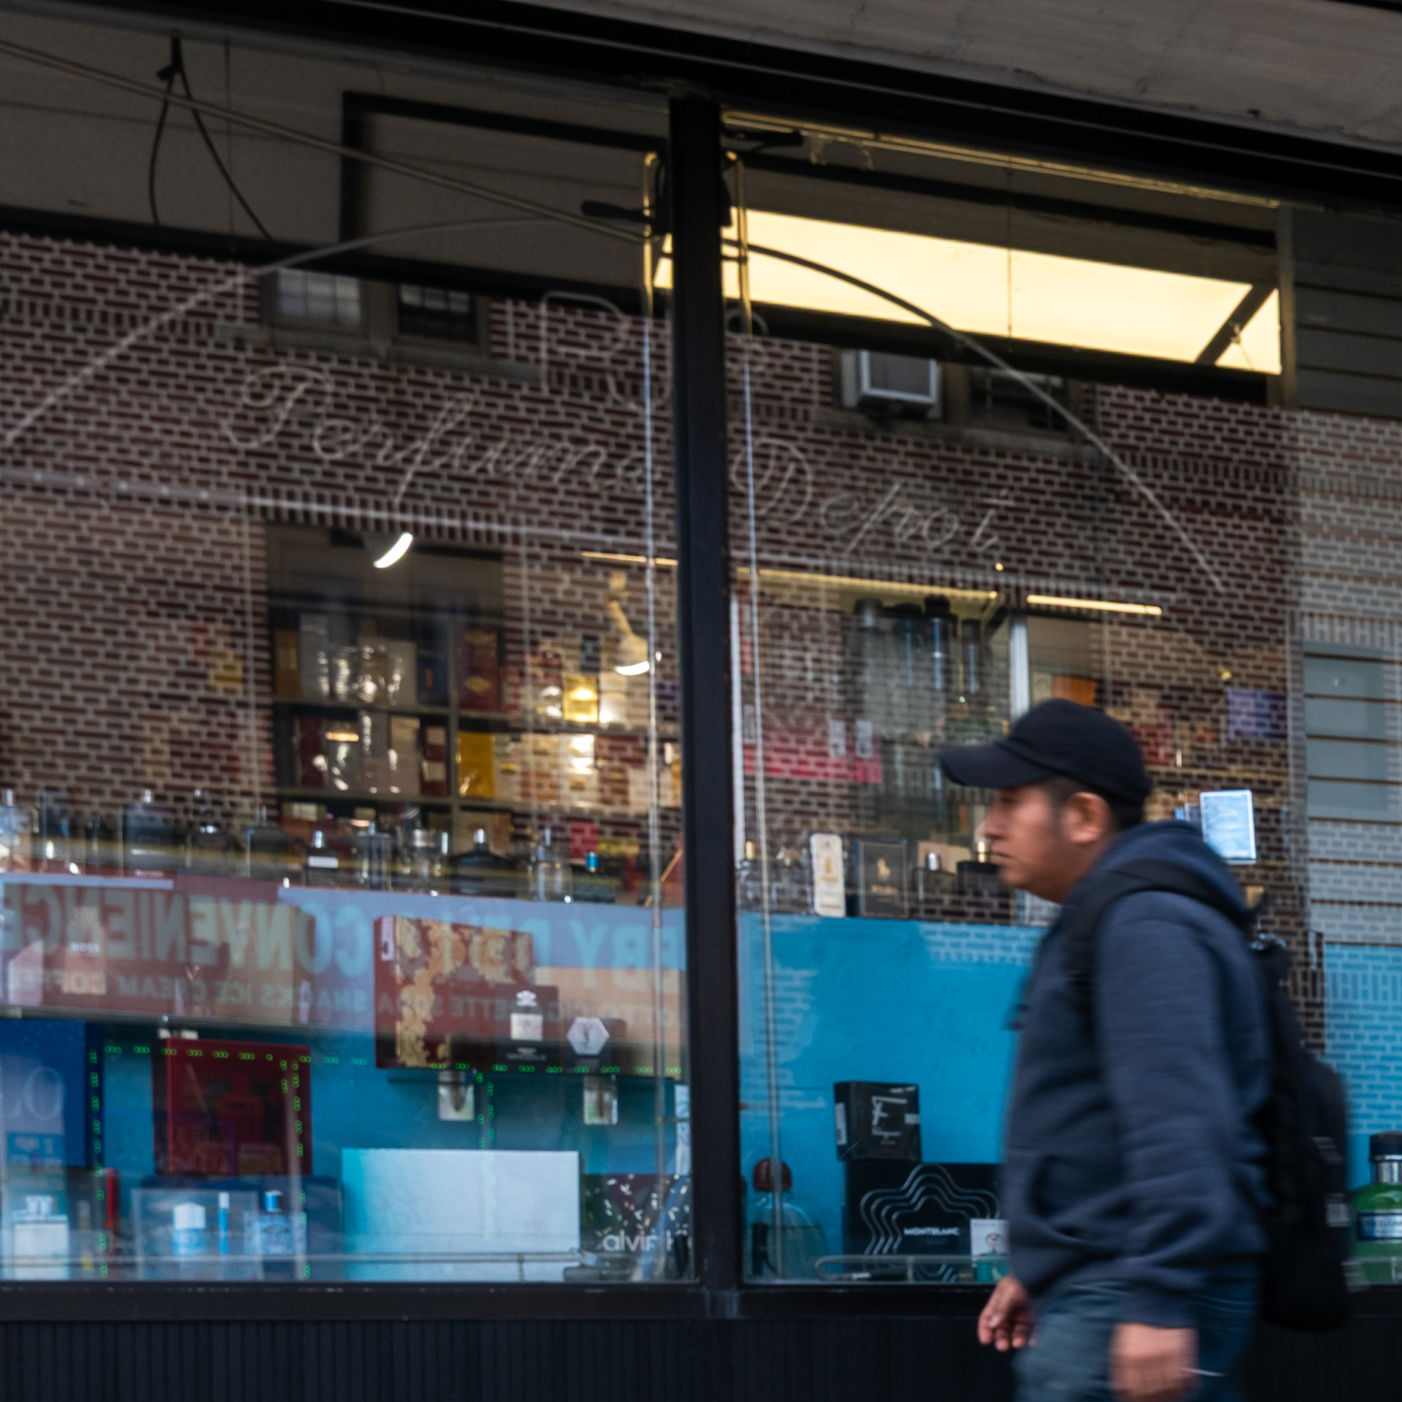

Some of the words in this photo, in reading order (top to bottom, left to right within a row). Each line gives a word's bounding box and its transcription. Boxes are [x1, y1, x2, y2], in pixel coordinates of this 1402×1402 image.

[219, 363, 664, 506] Perfume
[730, 436, 1016, 557] Depot
[903, 1226, 960, 1237] MONTBLANC
